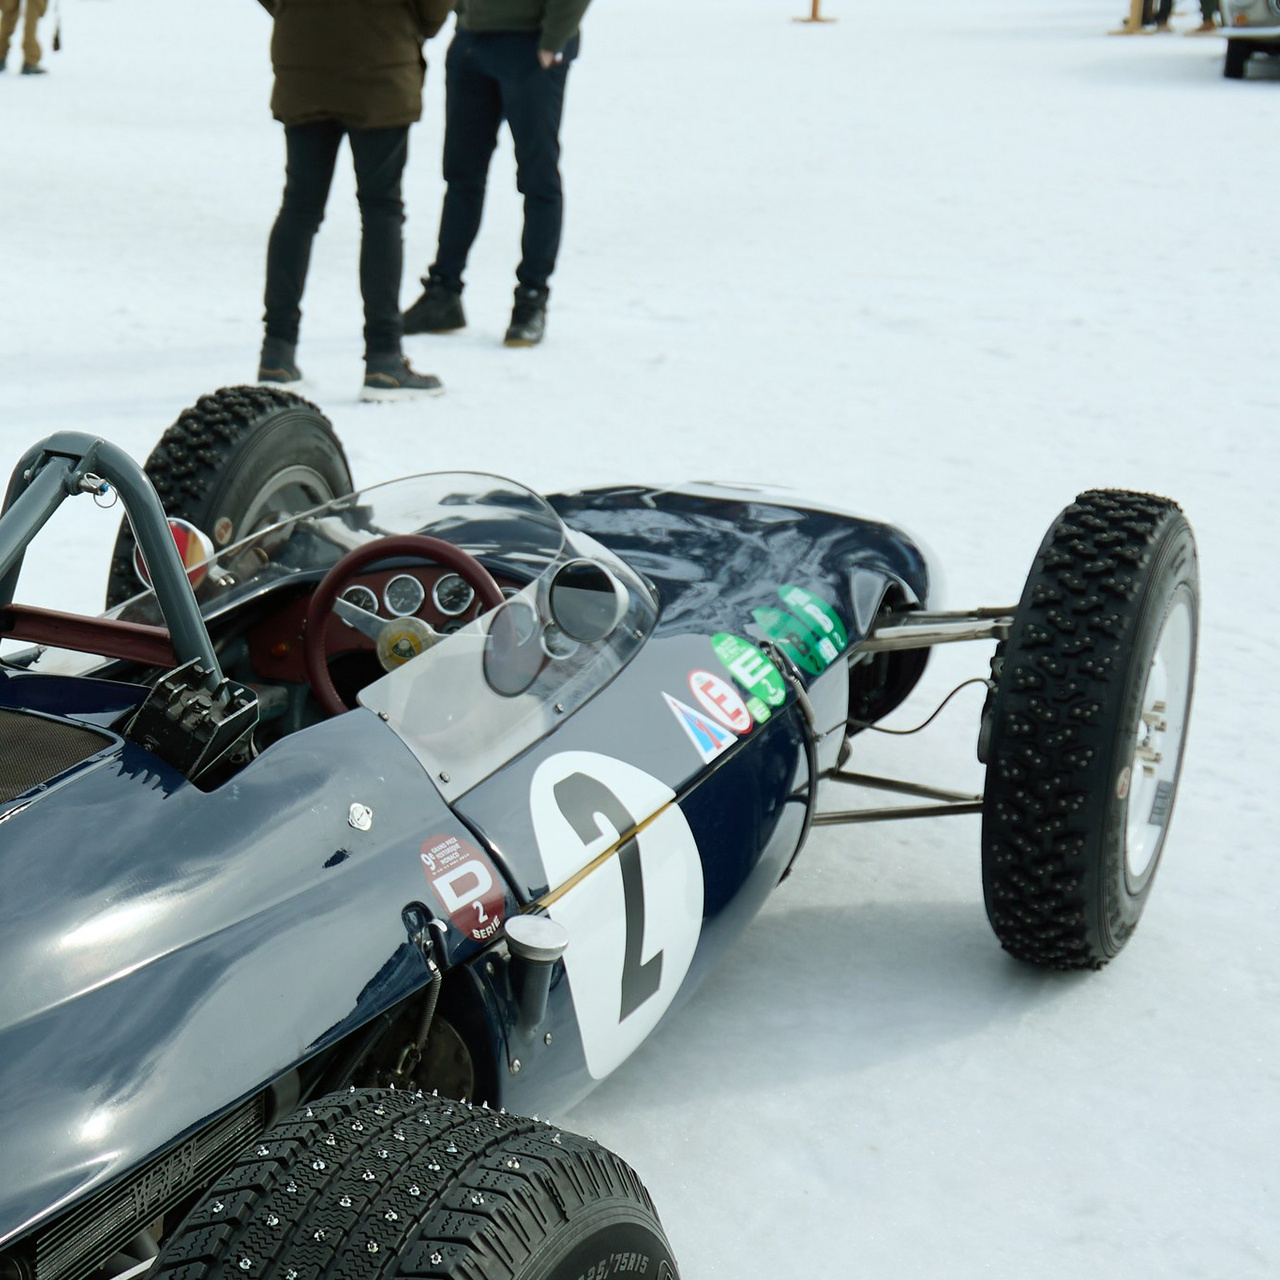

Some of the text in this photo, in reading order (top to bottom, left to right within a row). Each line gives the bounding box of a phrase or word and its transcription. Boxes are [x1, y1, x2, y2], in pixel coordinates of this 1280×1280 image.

[729, 648, 774, 688] E
[700, 680, 743, 722] E
[421, 852, 436, 871] 9e
[432, 860, 493, 913] D
[553, 772, 664, 1024] 2
[472, 901, 488, 923] 2
[472, 915, 501, 939] SERIE
